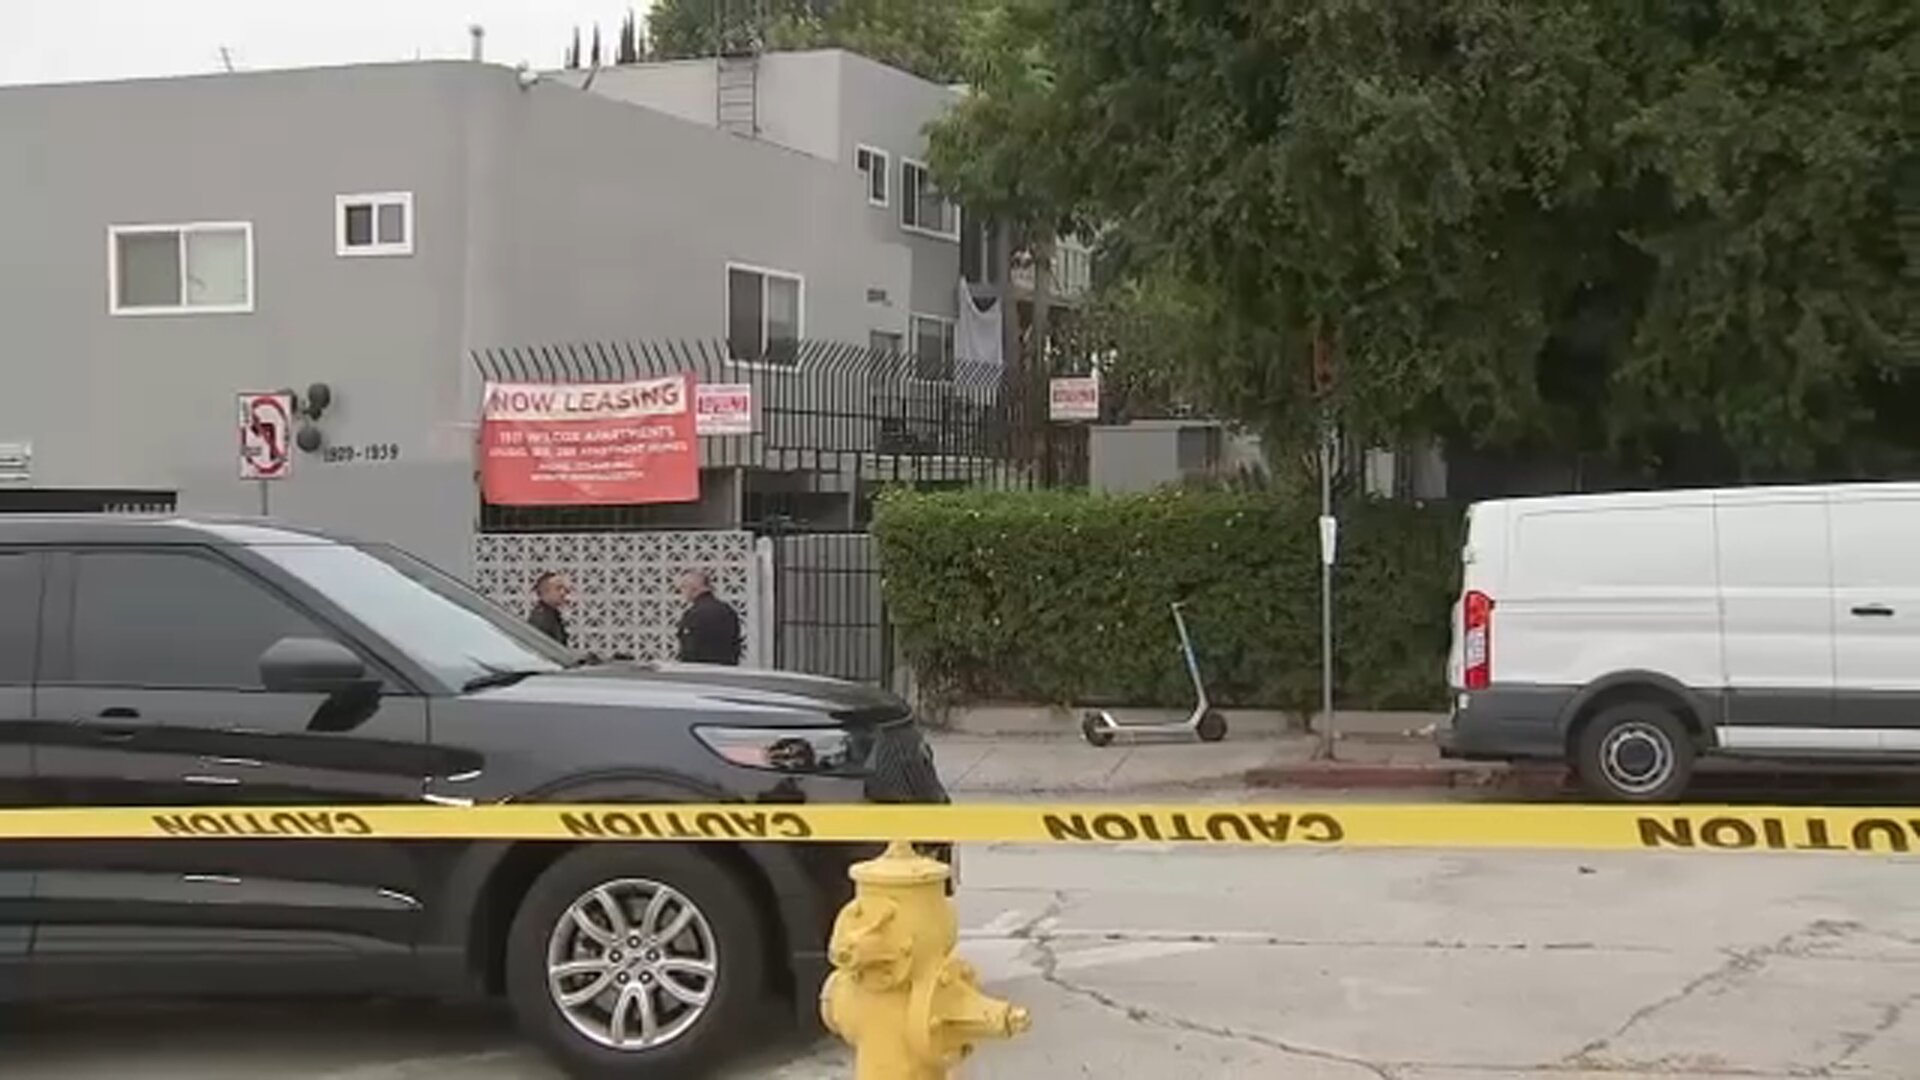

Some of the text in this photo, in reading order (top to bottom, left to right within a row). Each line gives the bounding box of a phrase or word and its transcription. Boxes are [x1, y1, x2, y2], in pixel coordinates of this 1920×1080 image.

[489, 391, 552, 412] NOW
[564, 383, 679, 412] LEASING
[584, 424, 676, 442] APARTMENTS
[151, 811, 373, 835] CAUTION
[560, 811, 812, 837] CAUTION
[1042, 812, 1345, 842] CAUTION
